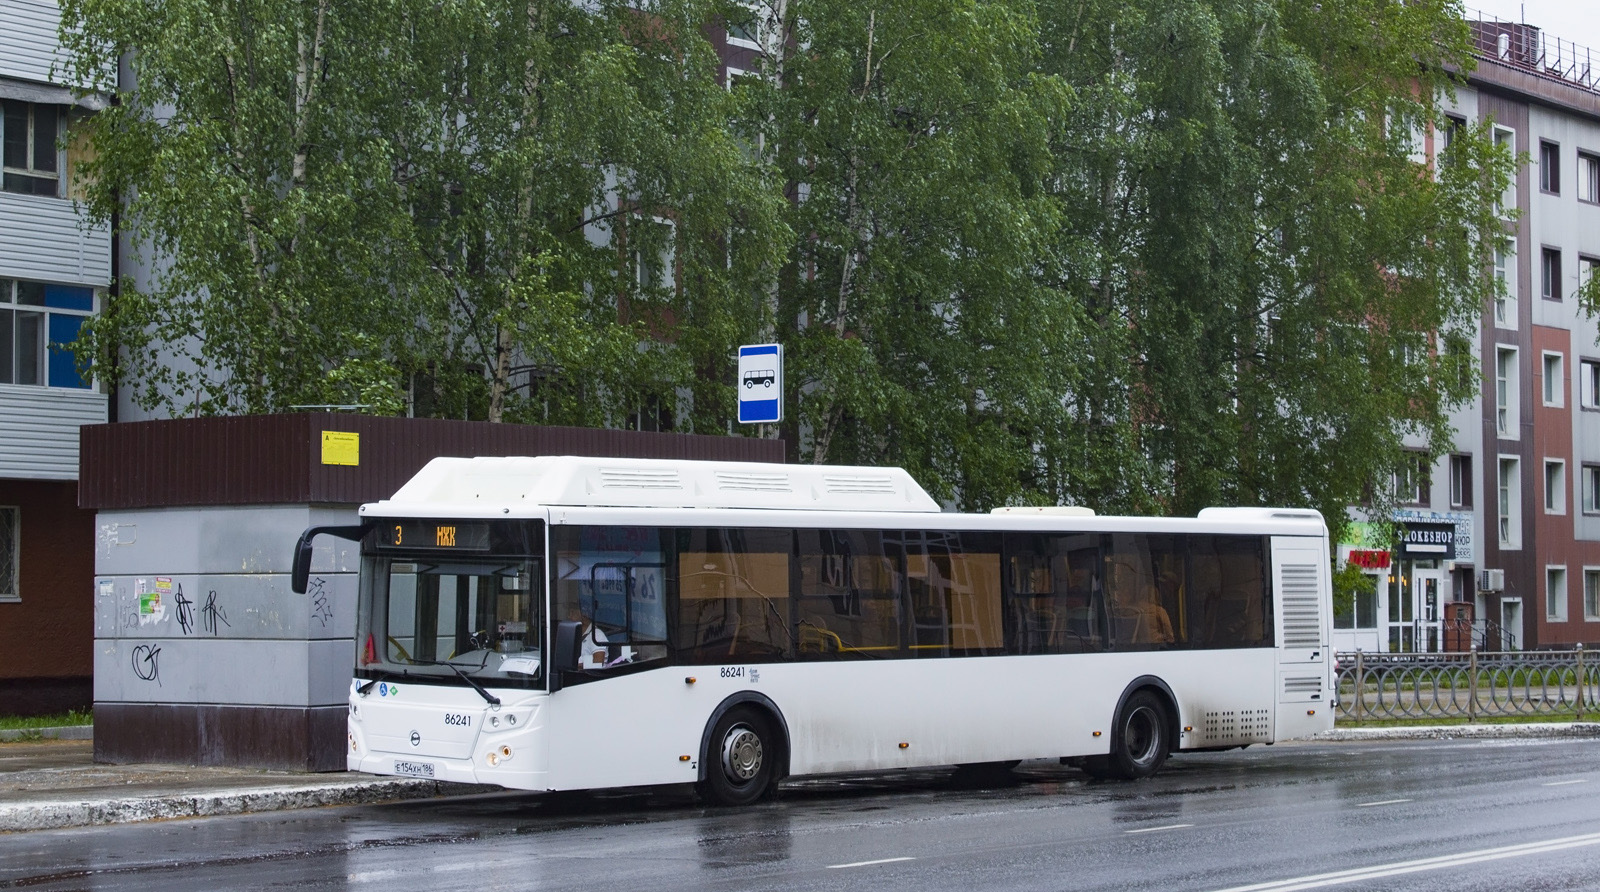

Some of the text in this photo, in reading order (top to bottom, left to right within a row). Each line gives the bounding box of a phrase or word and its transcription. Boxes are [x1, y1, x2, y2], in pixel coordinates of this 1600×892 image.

[395, 525, 456, 546] 3 МЖК
[720, 666, 745, 678] 86241
[444, 713, 471, 727] 86241
